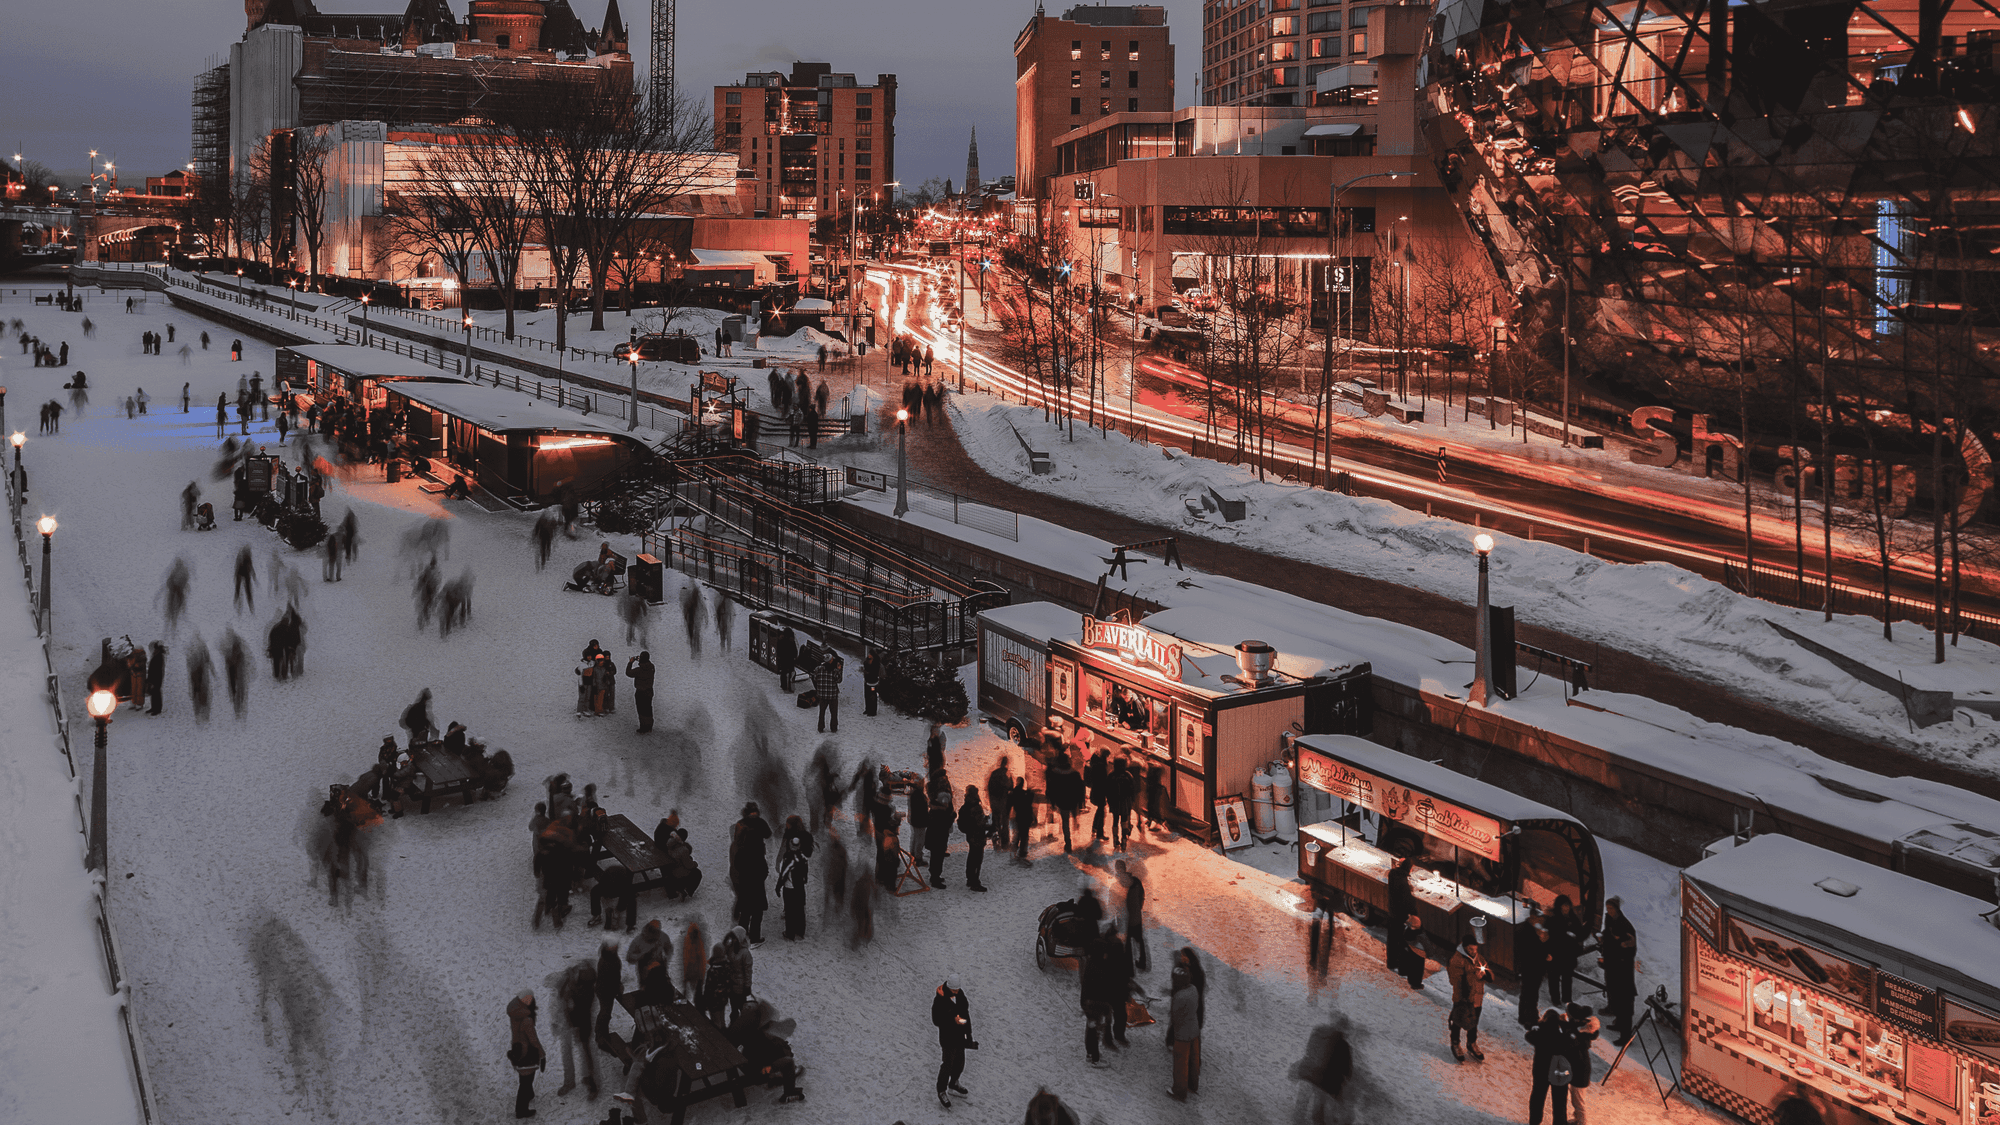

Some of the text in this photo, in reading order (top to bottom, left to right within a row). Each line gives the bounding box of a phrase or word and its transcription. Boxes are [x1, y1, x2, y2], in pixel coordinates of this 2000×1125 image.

[1083, 615, 1180, 678] BEAVERTAILS
[1301, 757, 1372, 792] Maplelicious
[1700, 962, 1716, 973] HOT
[1700, 969, 1740, 988] APPLE CIDER
[1884, 980, 1923, 1001] BREAKFAST
[1890, 989, 1917, 1006] BURGER
[1880, 996, 1933, 1023] HAMBOURGEOIS
